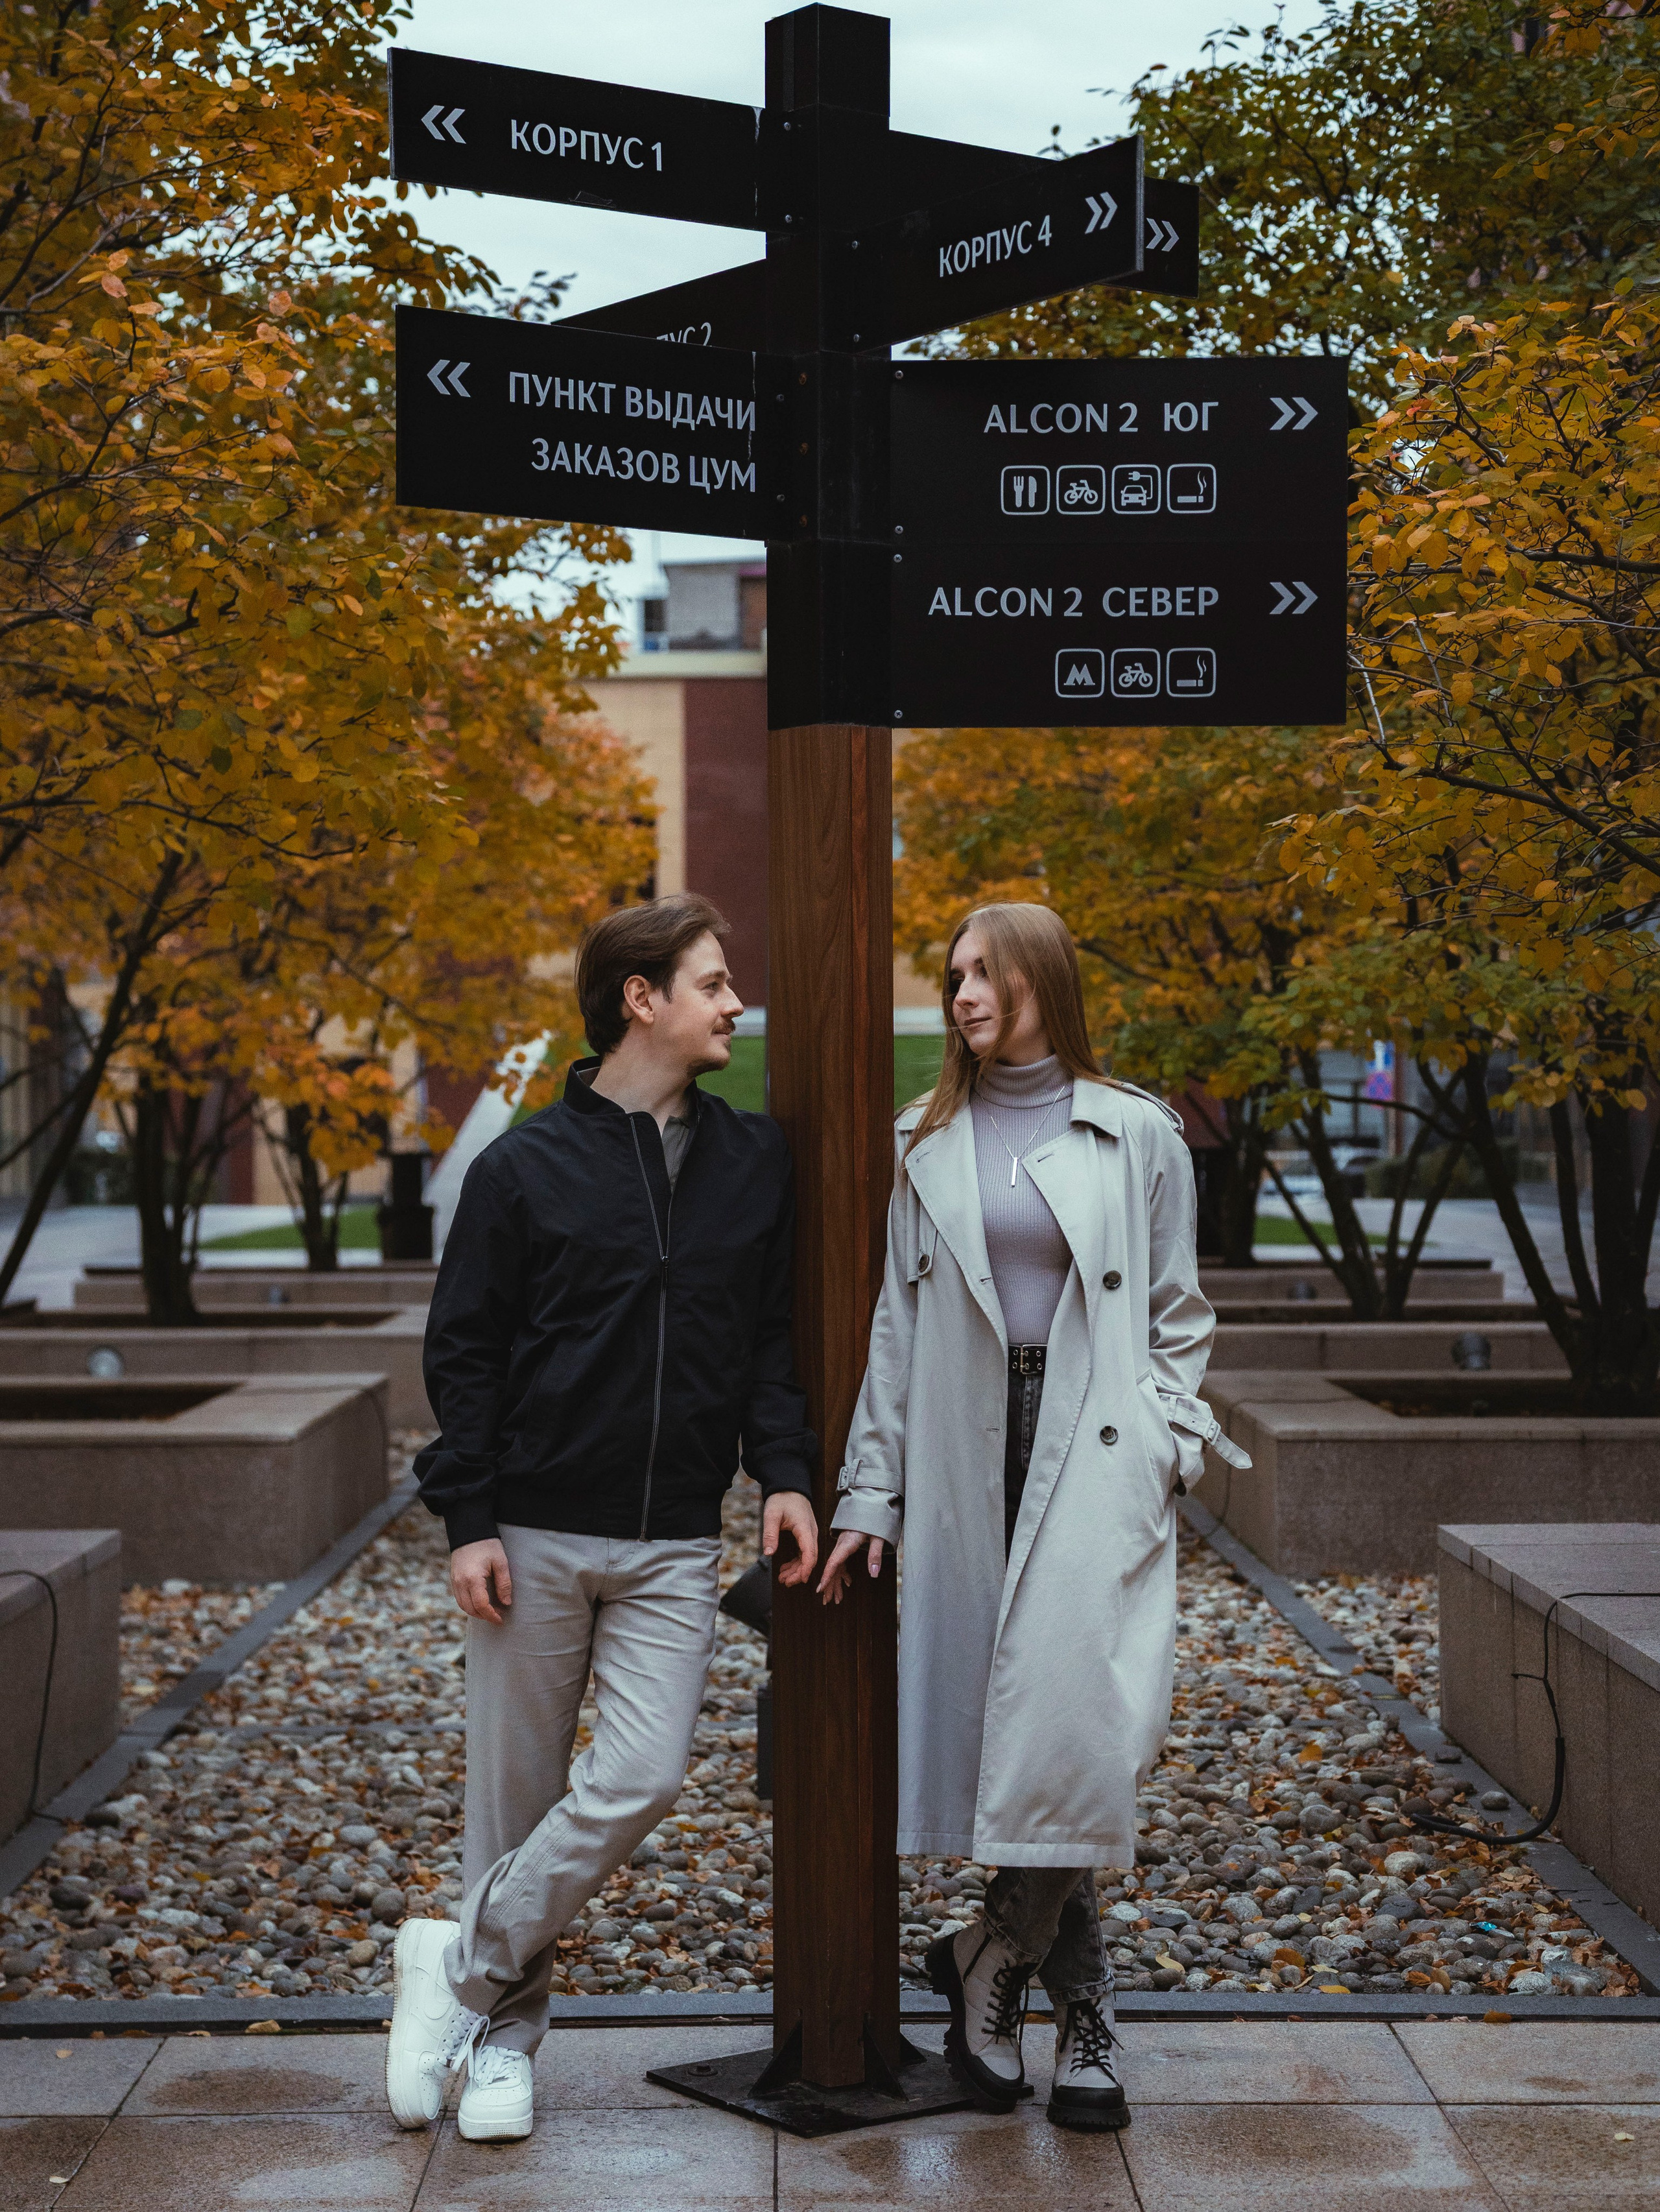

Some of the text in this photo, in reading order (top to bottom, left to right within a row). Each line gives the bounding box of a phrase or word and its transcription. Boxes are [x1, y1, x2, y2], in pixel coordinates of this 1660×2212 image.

[511, 119, 662, 172] КОРПУС 1
[940, 215, 1052, 278] КОРПУС 4
[509, 371, 755, 432] ПУНКТ ВЫДАЧИ
[983, 401, 1219, 434] ALCON 2 ЮГ
[531, 437, 755, 494] ЗАКАЗОВ ЦУМ
[928, 586, 1219, 617] ALCON 2 СЕВЕР
